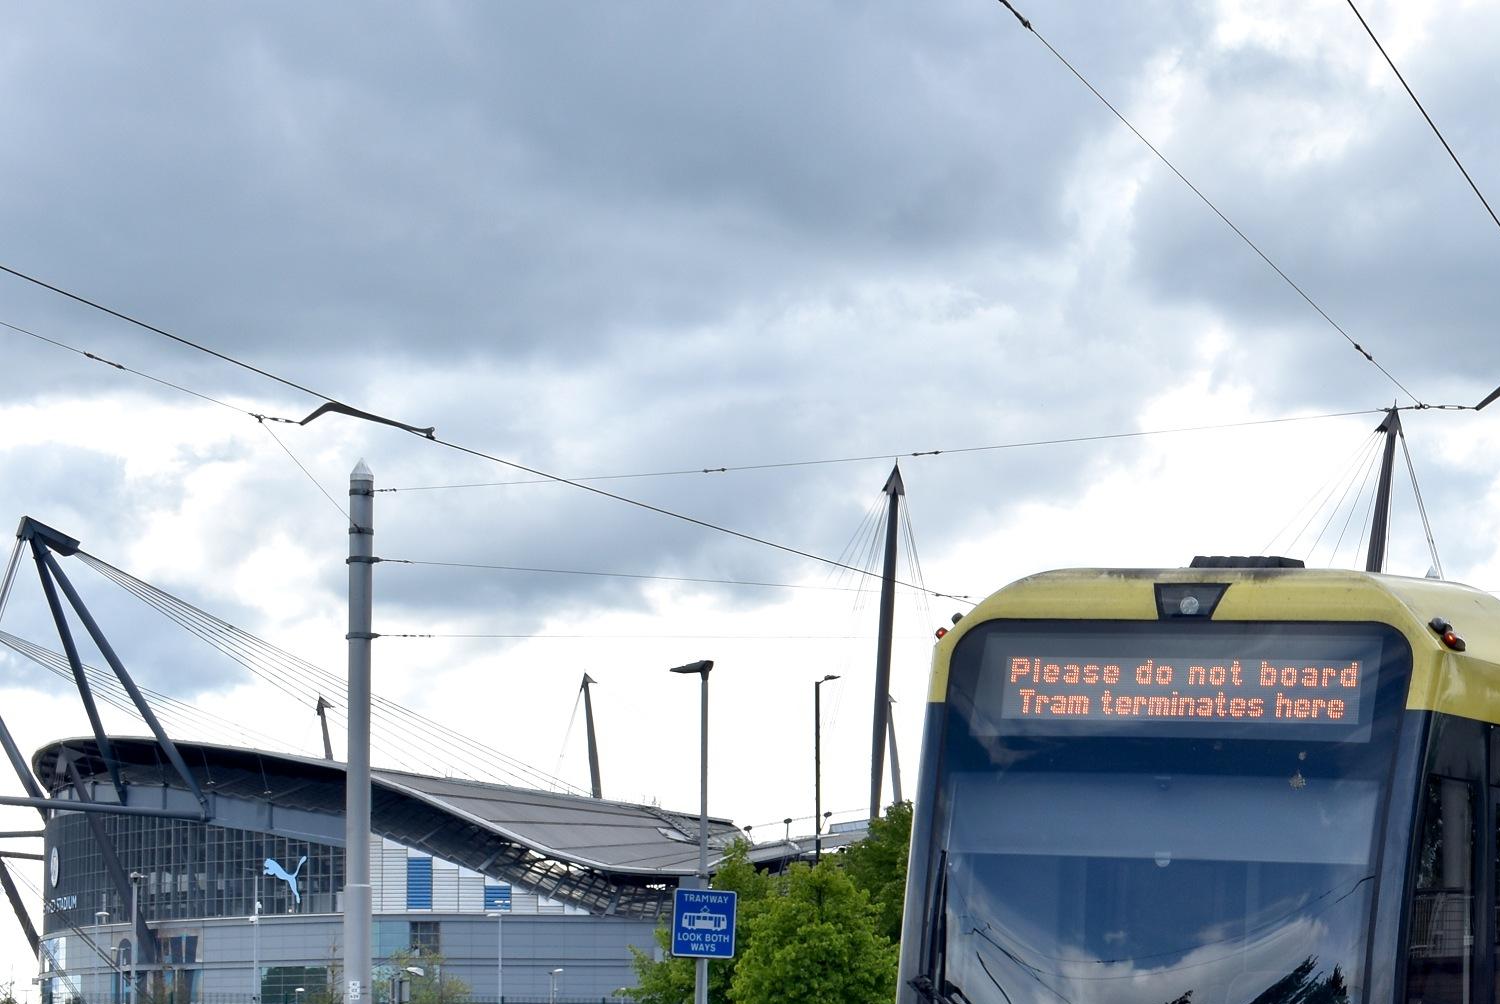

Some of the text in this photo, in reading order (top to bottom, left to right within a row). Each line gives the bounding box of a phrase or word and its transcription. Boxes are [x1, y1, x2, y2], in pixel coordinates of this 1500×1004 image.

[1010, 657, 1359, 688] Please do not board
[1019, 688, 1345, 720] Tram terminates here
[683, 893, 729, 904] TRAMWAY
[677, 932, 730, 943] LOOK BOTH
[690, 942, 716, 952] WAYS
